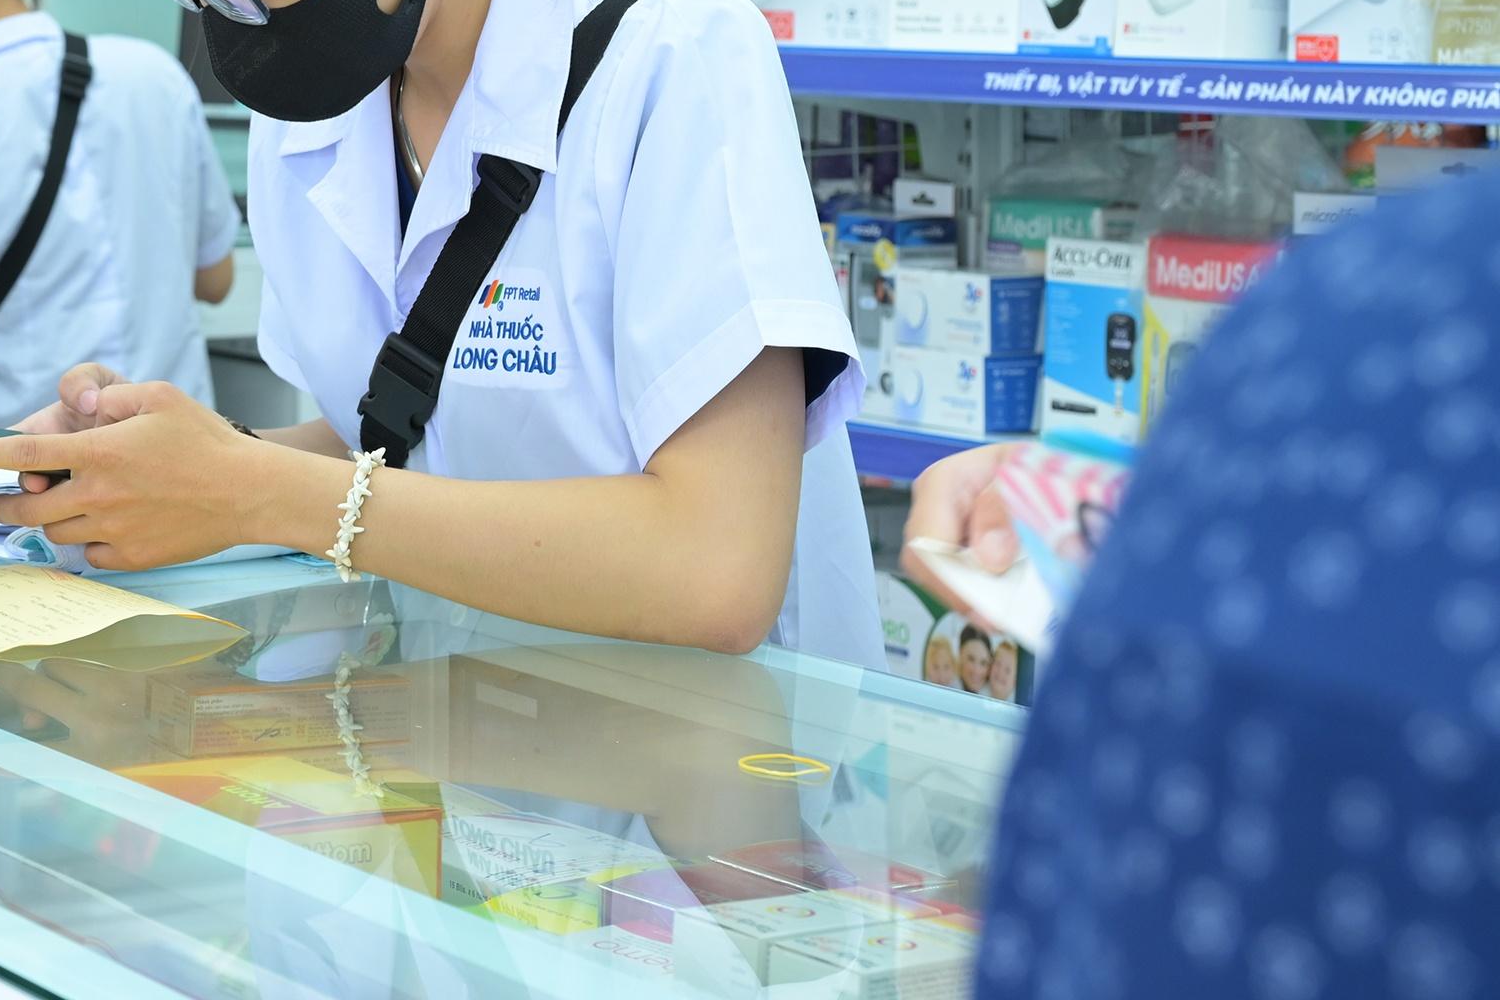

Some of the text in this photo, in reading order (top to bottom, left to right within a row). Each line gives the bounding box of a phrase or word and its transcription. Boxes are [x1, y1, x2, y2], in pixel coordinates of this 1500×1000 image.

[984, 67, 1037, 92] THIẾT
[1067, 70, 1106, 98] VẬT
[1109, 74, 1140, 96] TƯ
[1140, 77, 1154, 97] Y
[1156, 72, 1187, 99] TẾ
[1198, 74, 1243, 101] SẢN
[1245, 76, 1310, 104] PHẨM
[1313, 80, 1362, 105] NÀY
[1363, 82, 1447, 109] KHÔNG
[503, 286, 541, 302] FPT Retail
[468, 314, 544, 342] NHÀ THUỐC
[453, 344, 557, 376] LONG CHÂU
